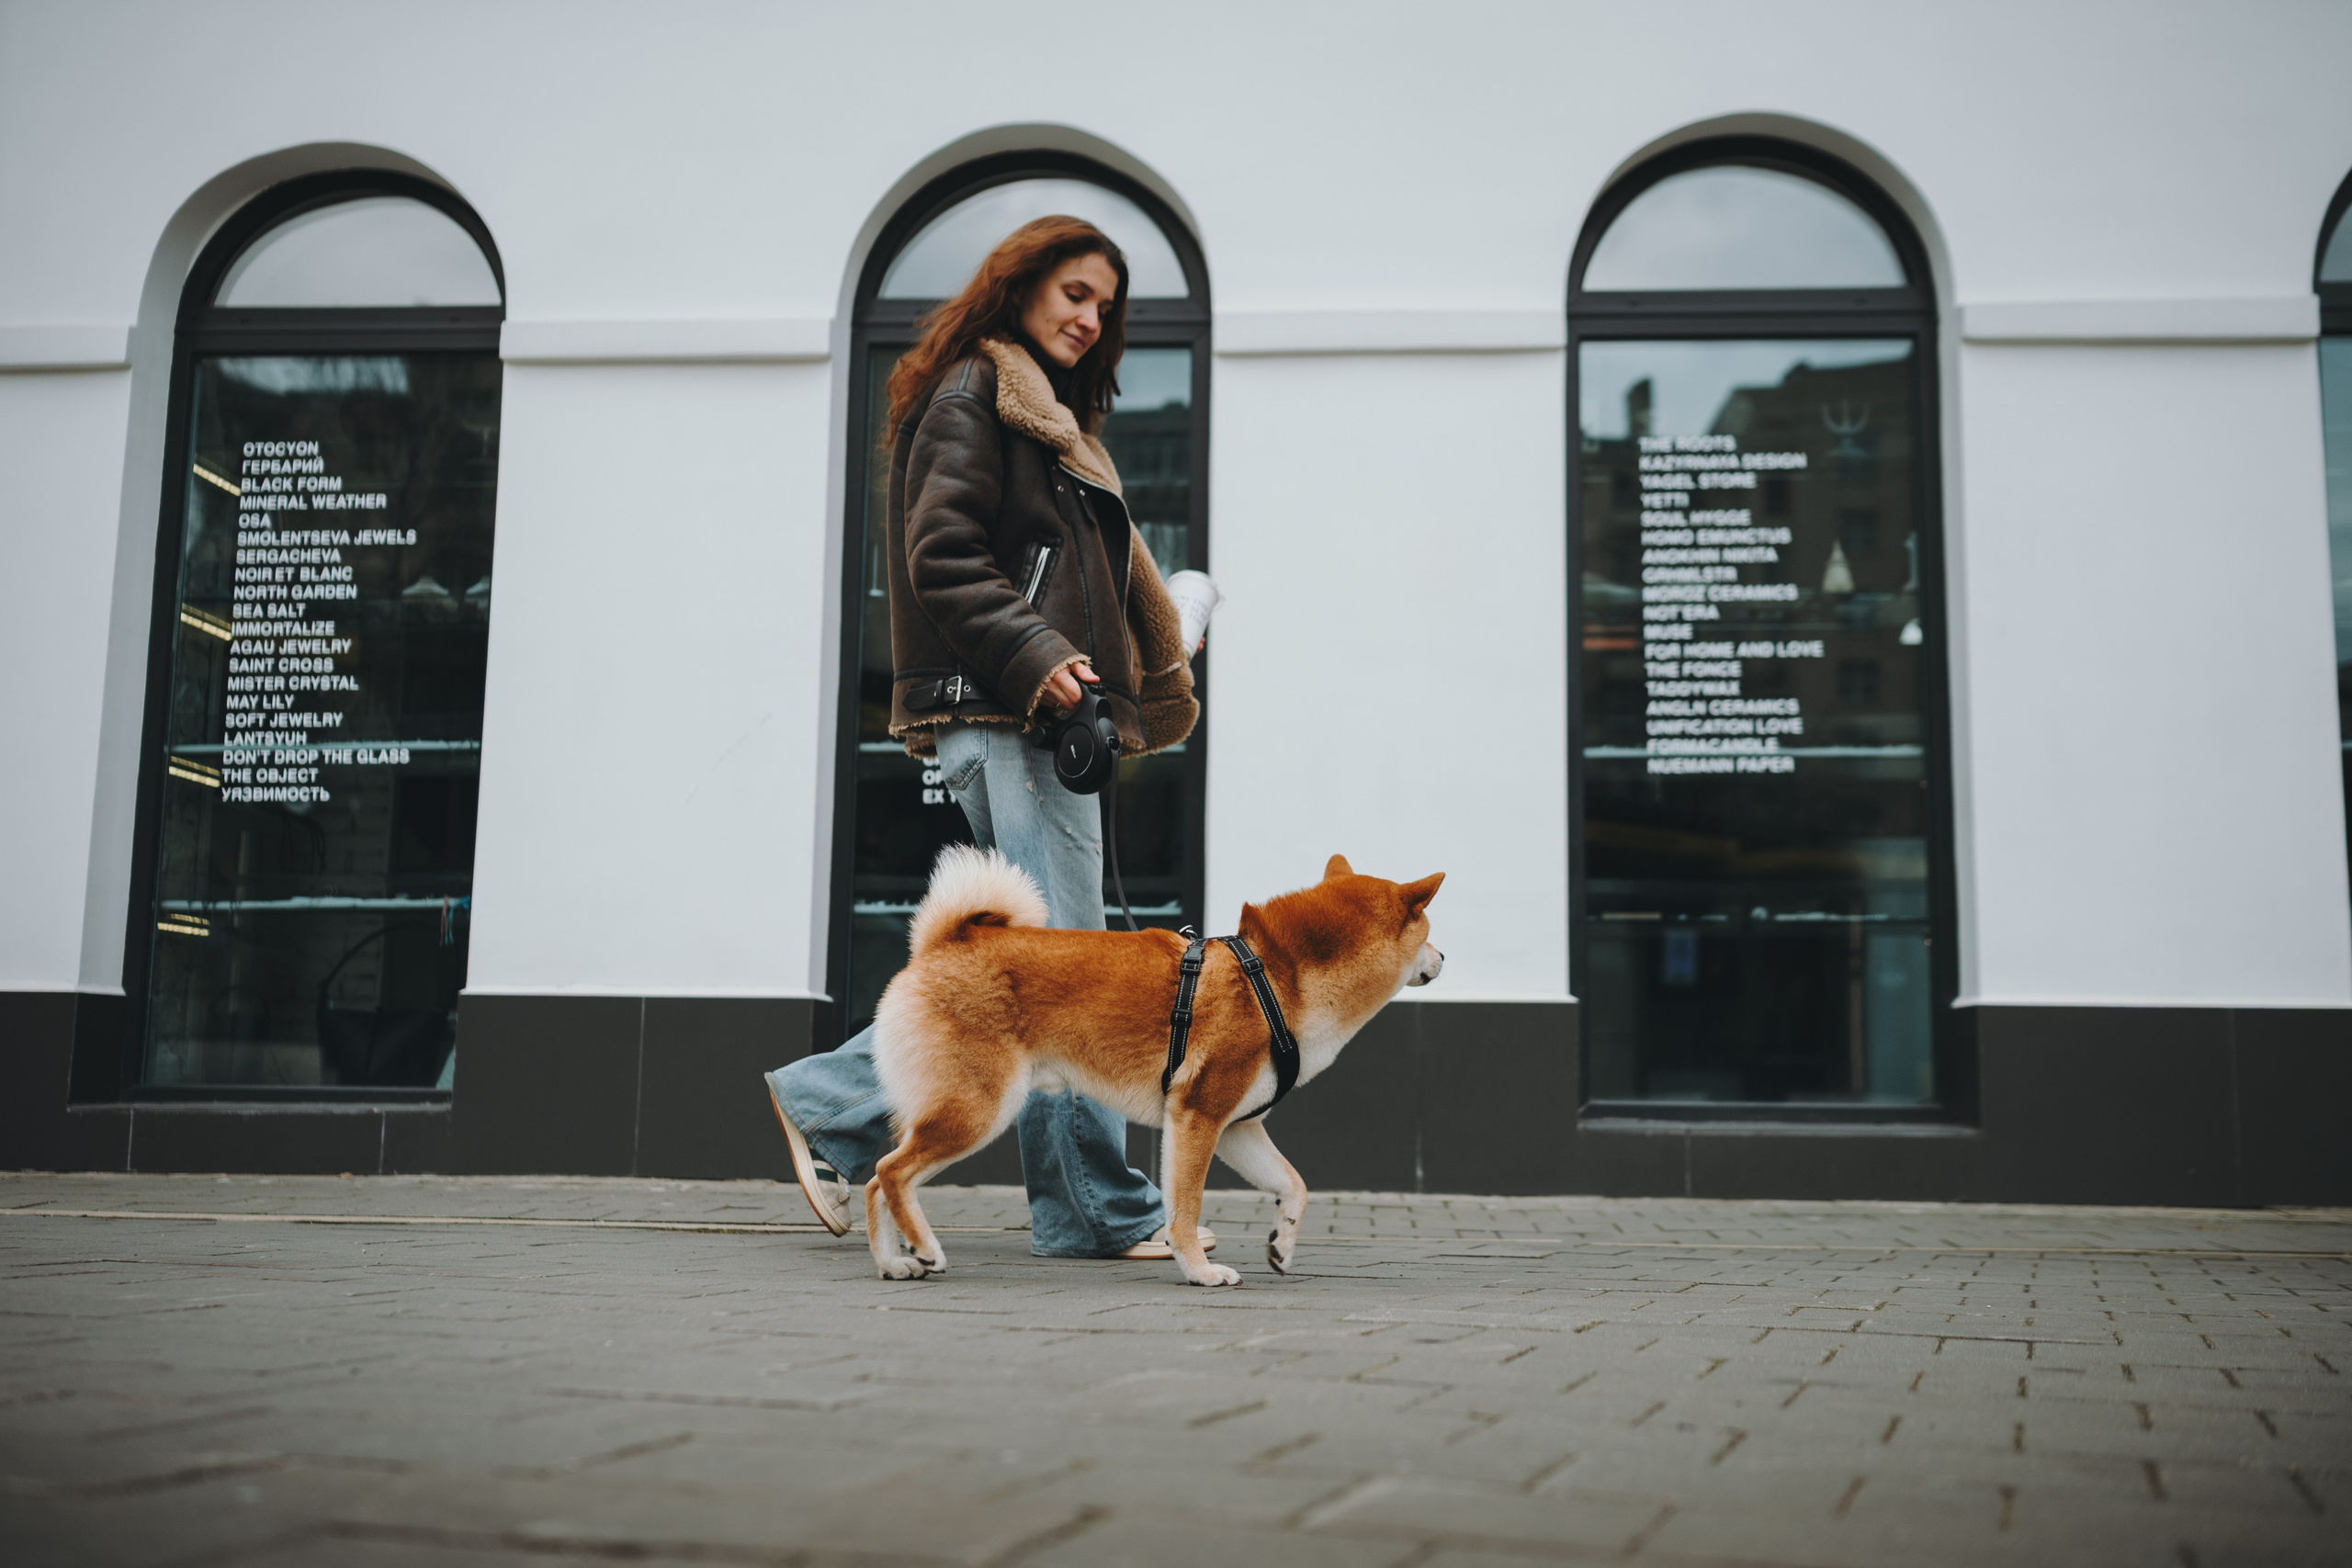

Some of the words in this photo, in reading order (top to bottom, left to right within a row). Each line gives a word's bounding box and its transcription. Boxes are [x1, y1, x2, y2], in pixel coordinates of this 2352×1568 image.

[243, 441, 319, 457] OTOCYON
[1639, 436, 1673, 453] THE
[1676, 435, 1736, 452] ROOTS
[243, 456, 324, 475] ГЕРБАРИЙ
[1741, 453, 1807, 469] DESIGN
[241, 477, 292, 492] BLACK
[297, 477, 342, 491] FORM
[1698, 472, 1758, 489] STORE
[240, 494, 307, 510] MINERAL
[312, 493, 387, 509] WEATHER
[1641, 492, 1690, 509] YETTI
[239, 513, 271, 528] OSA
[1641, 511, 1688, 527] SOUL
[1690, 509, 1752, 526] HYGGE
[238, 530, 350, 546] SMOLENTSEVA
[354, 529, 417, 546] JEWELS
[1641, 529, 1694, 546] HOMO
[236, 548, 341, 564] SERGACHEVA
[1722, 547, 1779, 563] NIKITA
[235, 567, 272, 582] NOIR
[276, 567, 295, 581] ET
[300, 566, 353, 581] BLANC
[233, 585, 288, 600] NORTH
[291, 584, 357, 599] GARDEN
[1708, 584, 1799, 602] CERAMICS
[233, 604, 263, 618] SEA
[267, 603, 305, 618] SALT
[232, 621, 334, 637] IMMORTALIZE
[1644, 624, 1693, 640] MUSE
[231, 640, 275, 655] AGAU
[279, 639, 351, 654] JEWELRY
[1645, 643, 1681, 660] FOR
[1683, 641, 1735, 659] HOME
[1736, 641, 1775, 658] AND
[1777, 640, 1824, 658] LOVE
[229, 658, 275, 672] SAINT
[278, 658, 334, 672] CROSS
[1645, 662, 1679, 678] THE
[228, 677, 285, 692] MISTER
[288, 676, 359, 691] CRYSTAL
[226, 695, 259, 709] MAY
[263, 694, 294, 709] LILY
[1709, 698, 1800, 716] CERAMICS
[225, 713, 266, 728] SOFT
[269, 713, 343, 728] JEWELRY
[1646, 718, 1753, 736] UNIFICATION
[1756, 717, 1804, 735] LOVE
[224, 731, 307, 747] LANTSYUH
[223, 750, 270, 765] DON'T
[275, 750, 318, 764] DROP
[322, 749, 352, 764] THE
[356, 749, 410, 764] GLASS
[1736, 756, 1794, 773] PAPER
[221, 769, 251, 784] THE
[256, 768, 318, 783] OBJECT
[221, 786, 330, 802] УЯЗВИМОСТЬ
[923, 789, 944, 804] EX
